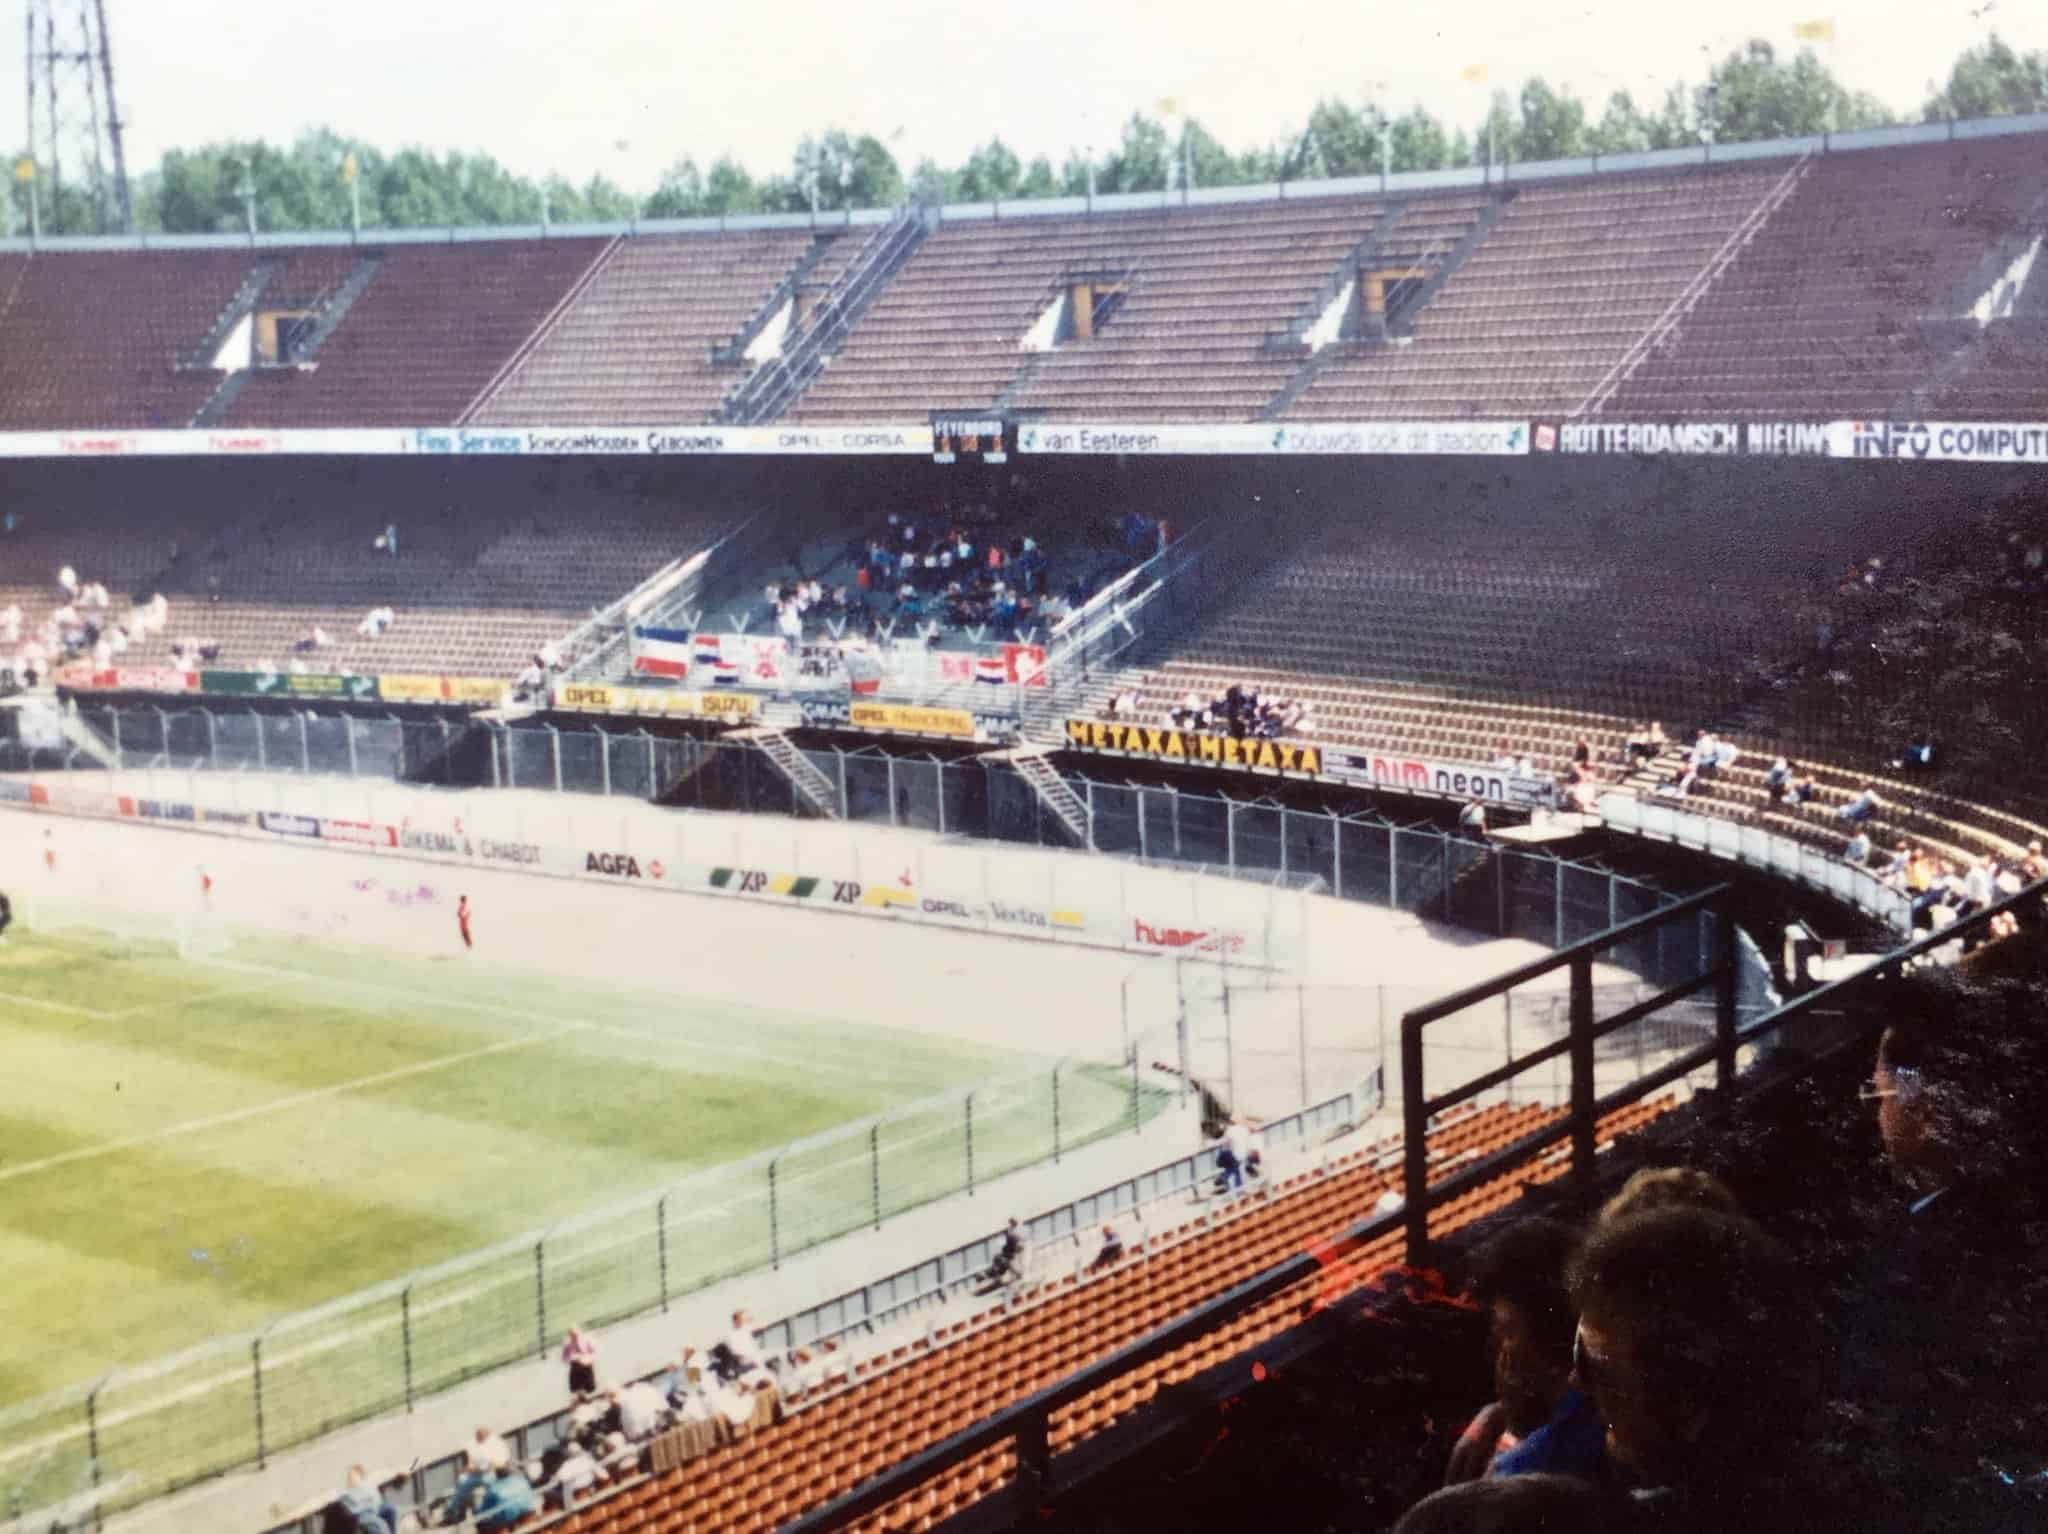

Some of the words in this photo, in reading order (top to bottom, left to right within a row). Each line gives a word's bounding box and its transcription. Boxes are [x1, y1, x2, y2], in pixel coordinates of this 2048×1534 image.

[1044, 434, 1074, 450] van
[1080, 430, 1160, 450] Eesteren
[1560, 424, 1738, 453] ROTTERDAMSCH
[1069, 719, 1185, 758] METAXA
[1199, 734, 1322, 775] METAXA
[1436, 770, 1504, 801] neon
[586, 852, 641, 878] AGFA
[741, 871, 768, 893] XP
[832, 880, 862, 904] XP
[921, 898, 970, 919] OPEL
